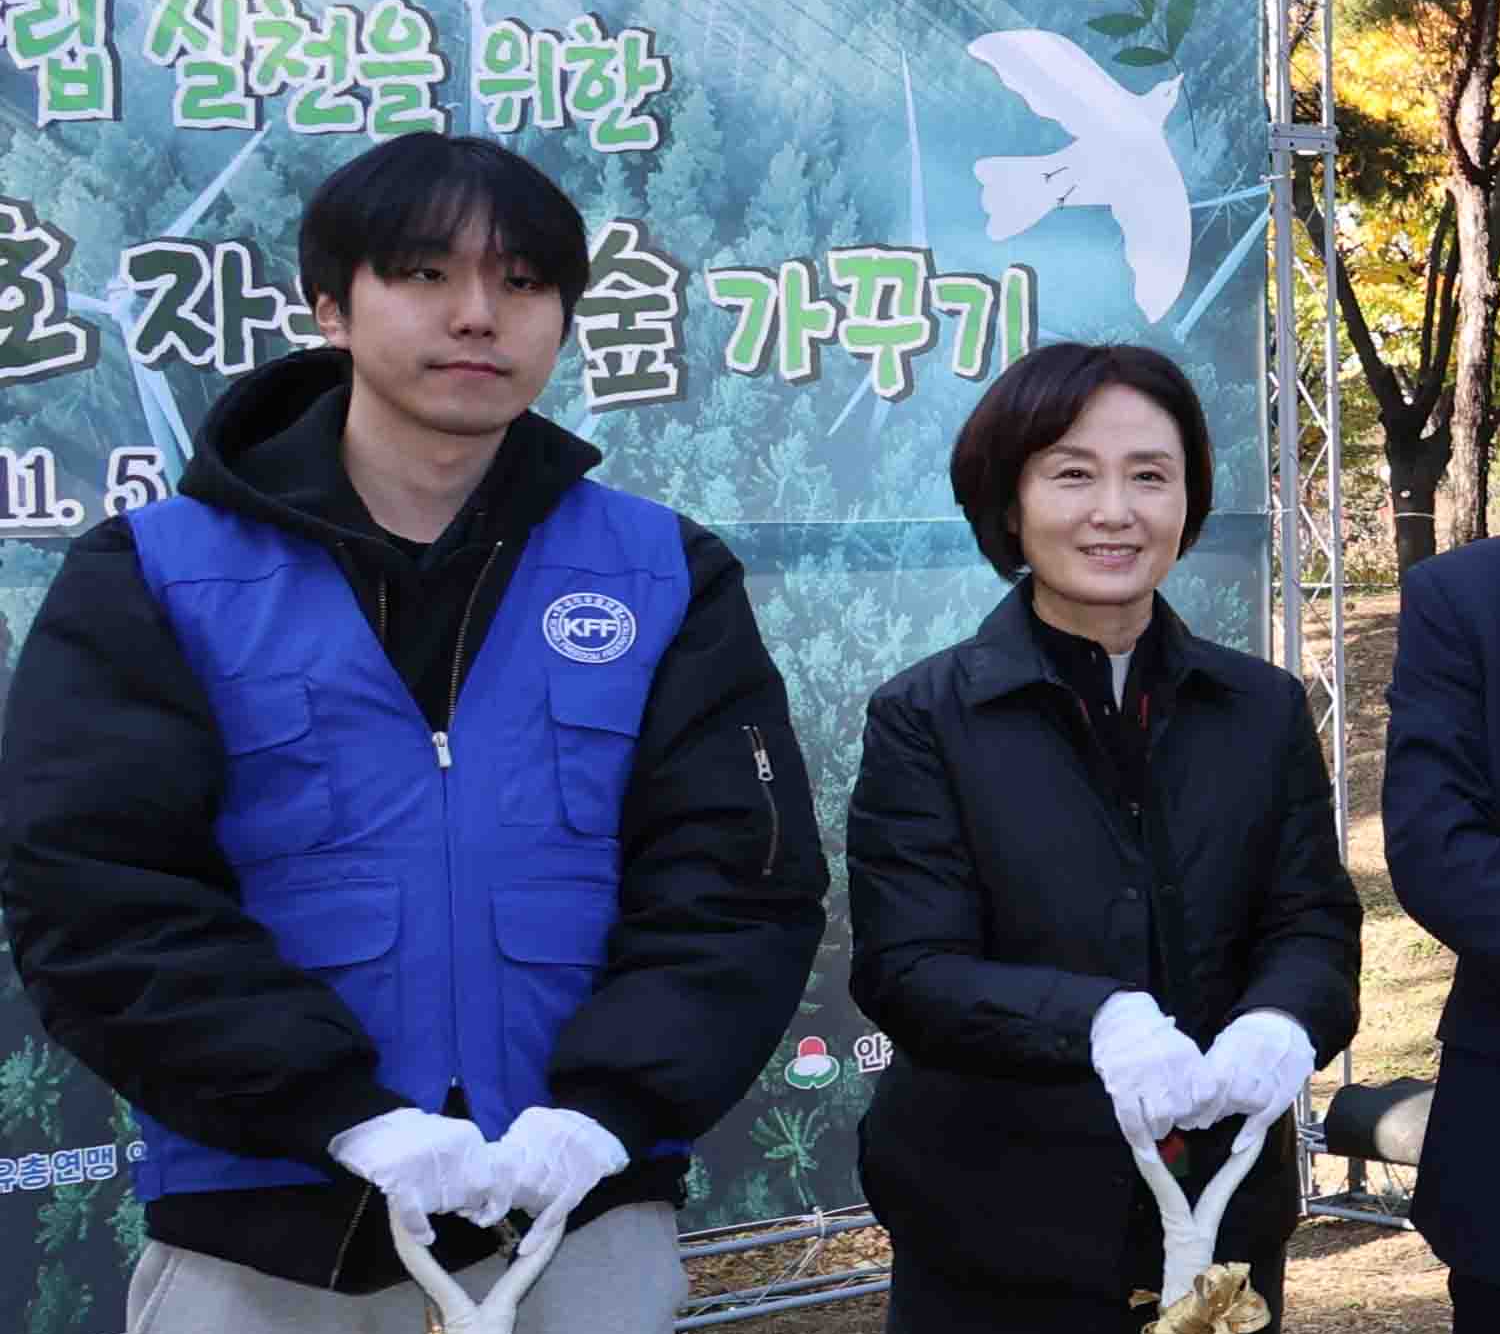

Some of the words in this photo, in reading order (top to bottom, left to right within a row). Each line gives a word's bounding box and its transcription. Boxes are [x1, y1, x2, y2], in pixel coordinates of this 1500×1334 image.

[476, 18, 662, 152] 위한
[574, 220, 681, 407] 숲
[704, 245, 1030, 398] 가꾸기
[563, 618, 617, 637] KFF
